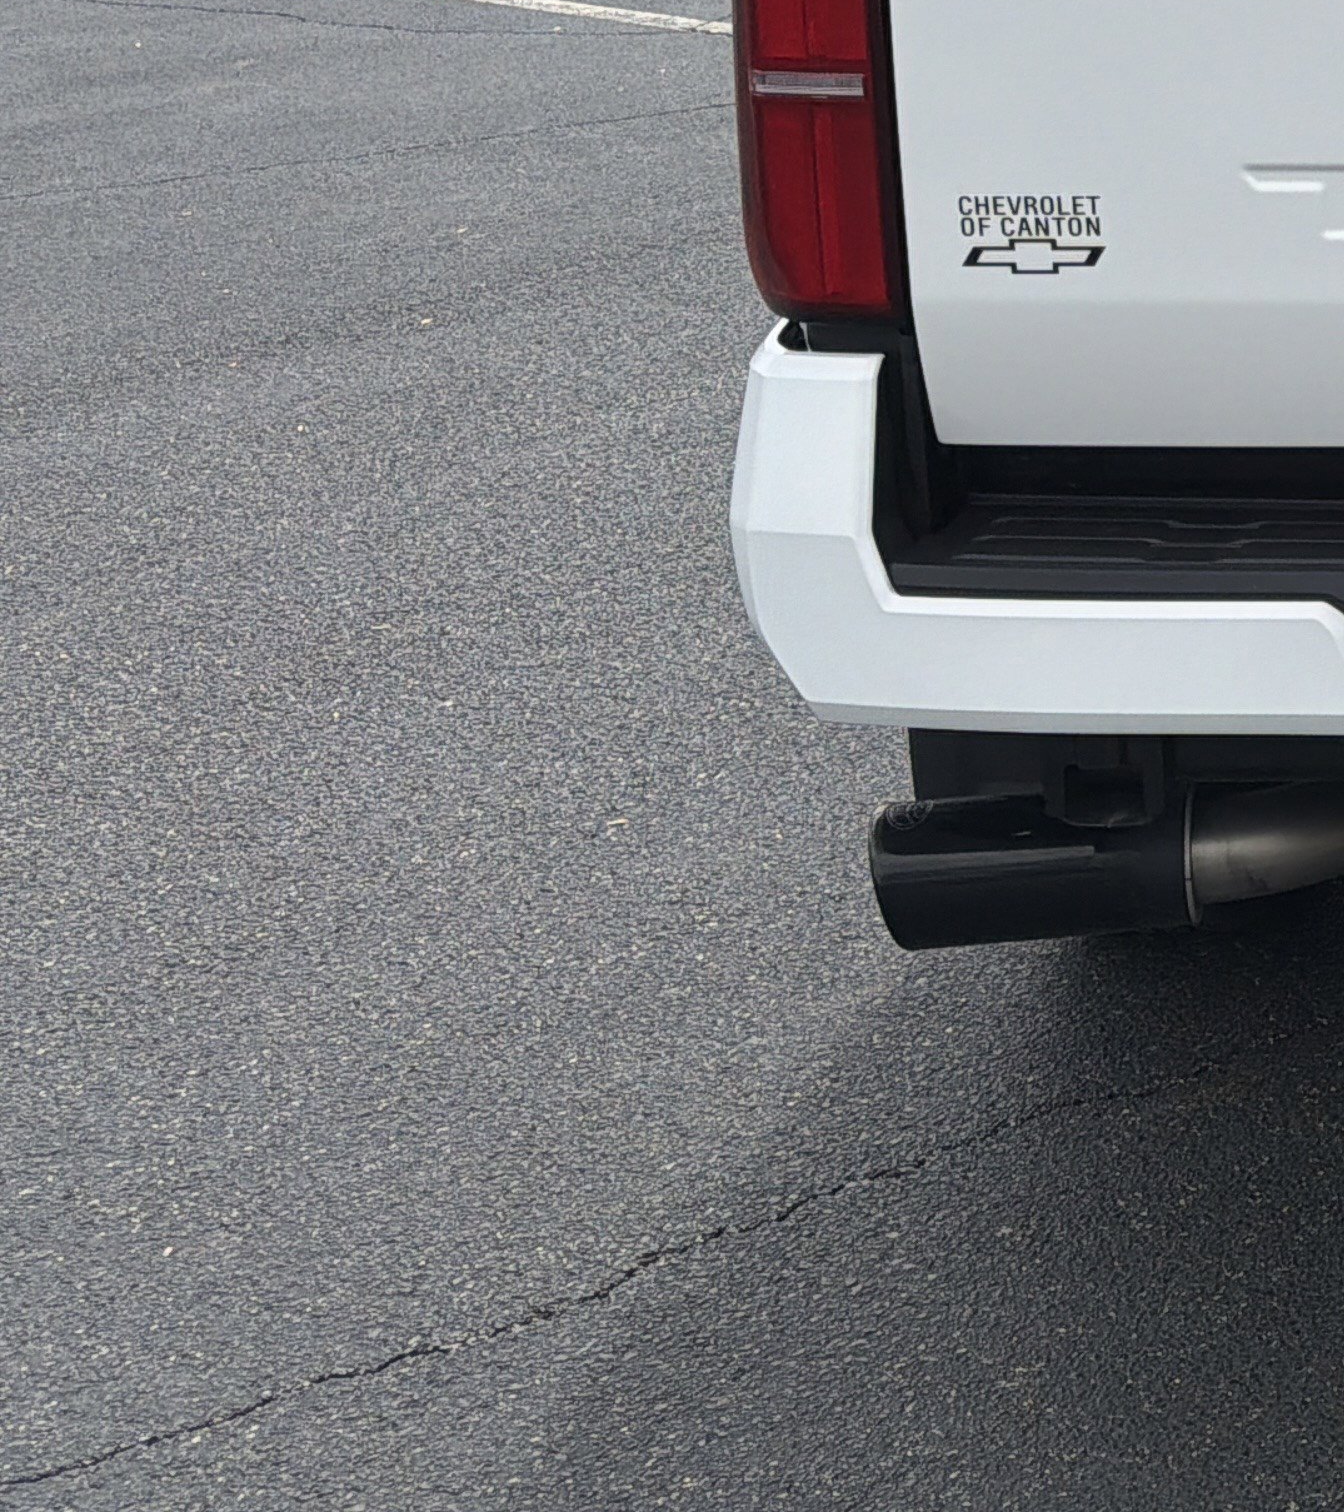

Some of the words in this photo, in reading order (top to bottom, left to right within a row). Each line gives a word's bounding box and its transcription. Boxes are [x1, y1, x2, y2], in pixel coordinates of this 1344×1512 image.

[958, 195, 1101, 216] CHEVROLET
[960, 217, 991, 237] OF
[1000, 217, 1101, 237] CANTON
